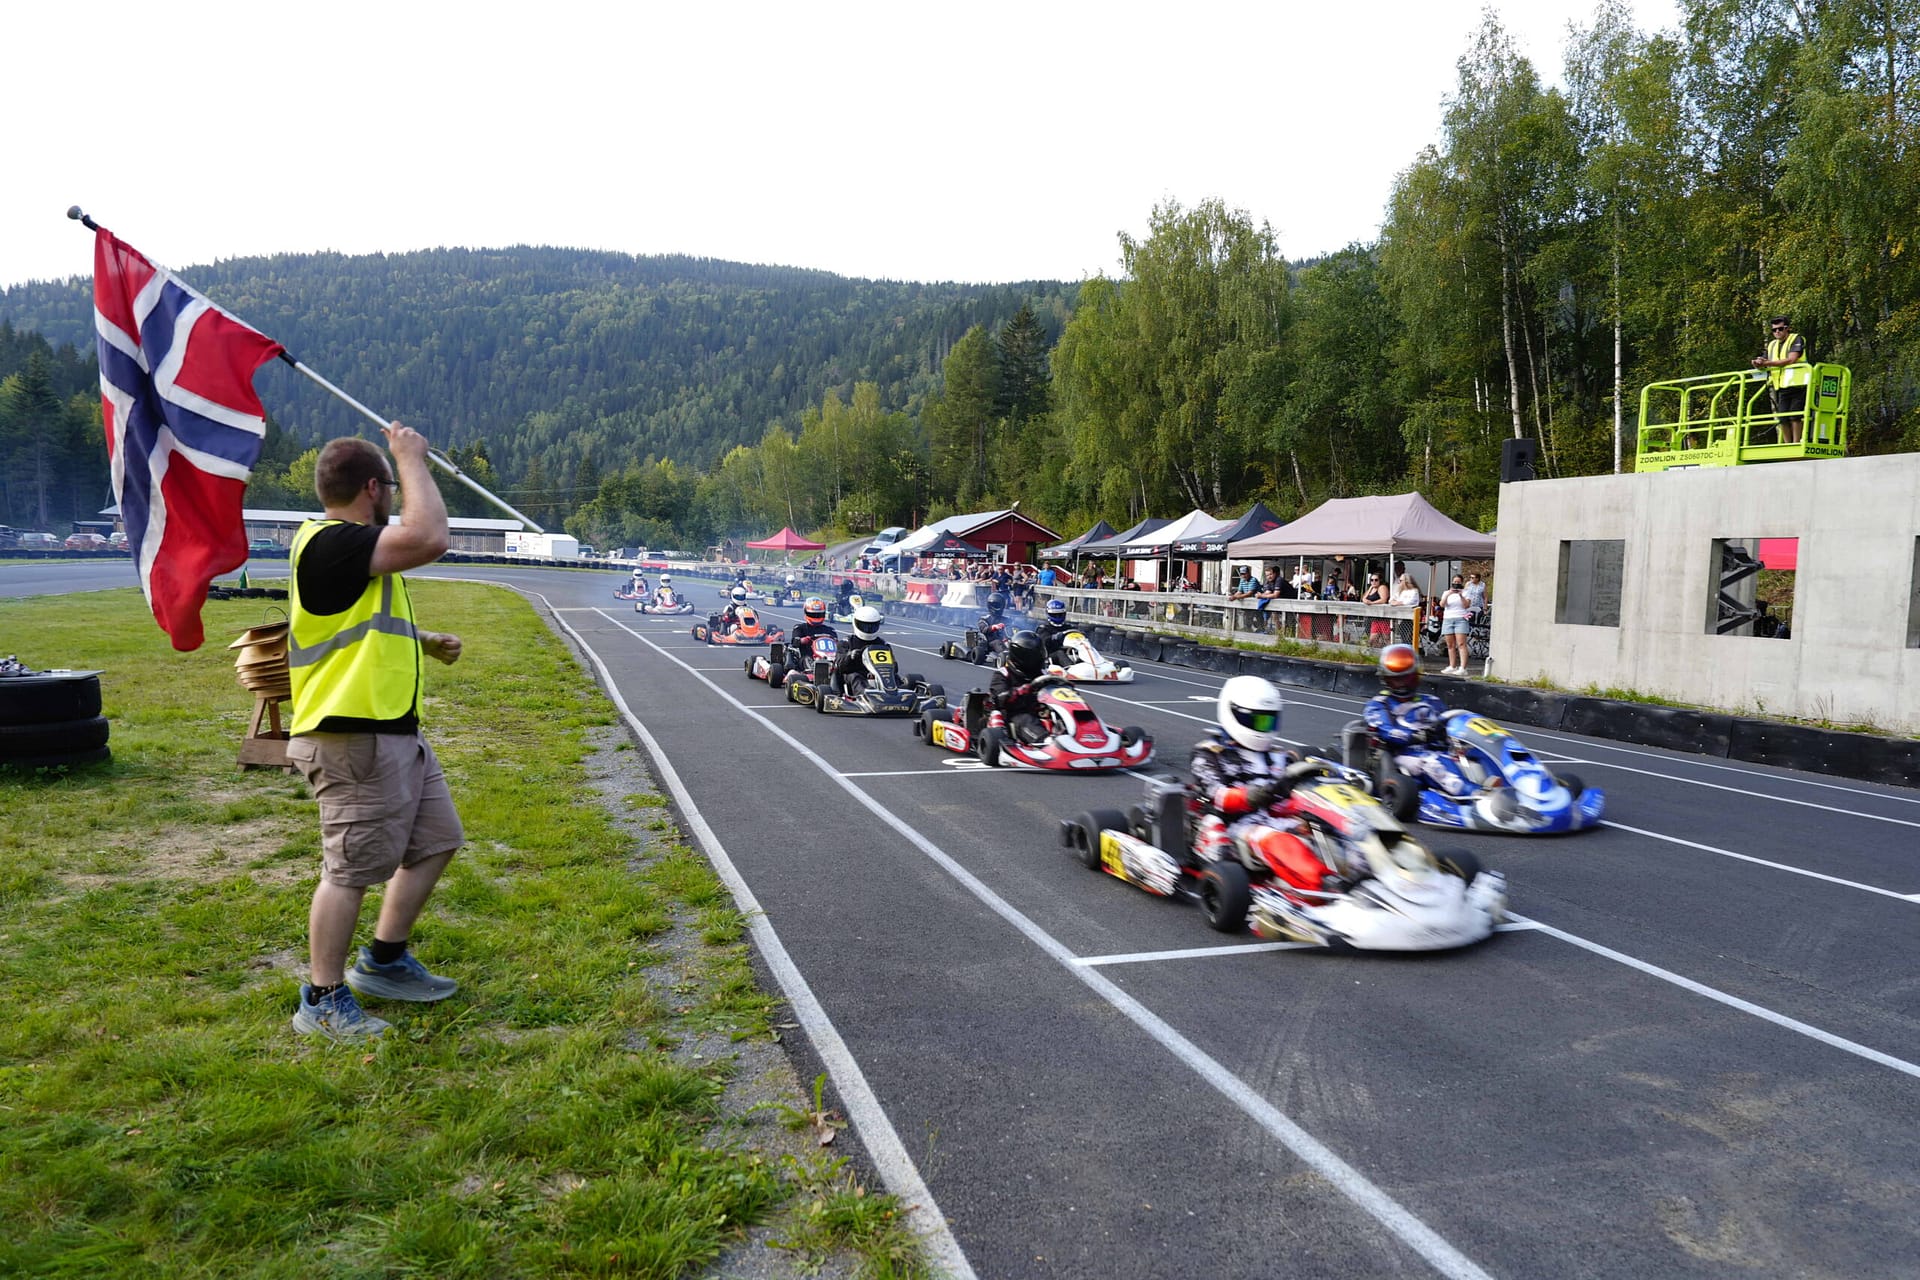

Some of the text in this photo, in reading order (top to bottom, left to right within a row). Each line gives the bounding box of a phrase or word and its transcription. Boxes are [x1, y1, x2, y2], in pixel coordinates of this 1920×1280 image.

[1823, 380, 1837, 392] RG
[1804, 446, 1843, 456] ZOOMLION
[1639, 455, 1676, 464] ZOOMLION
[875, 651, 888, 662] 6
